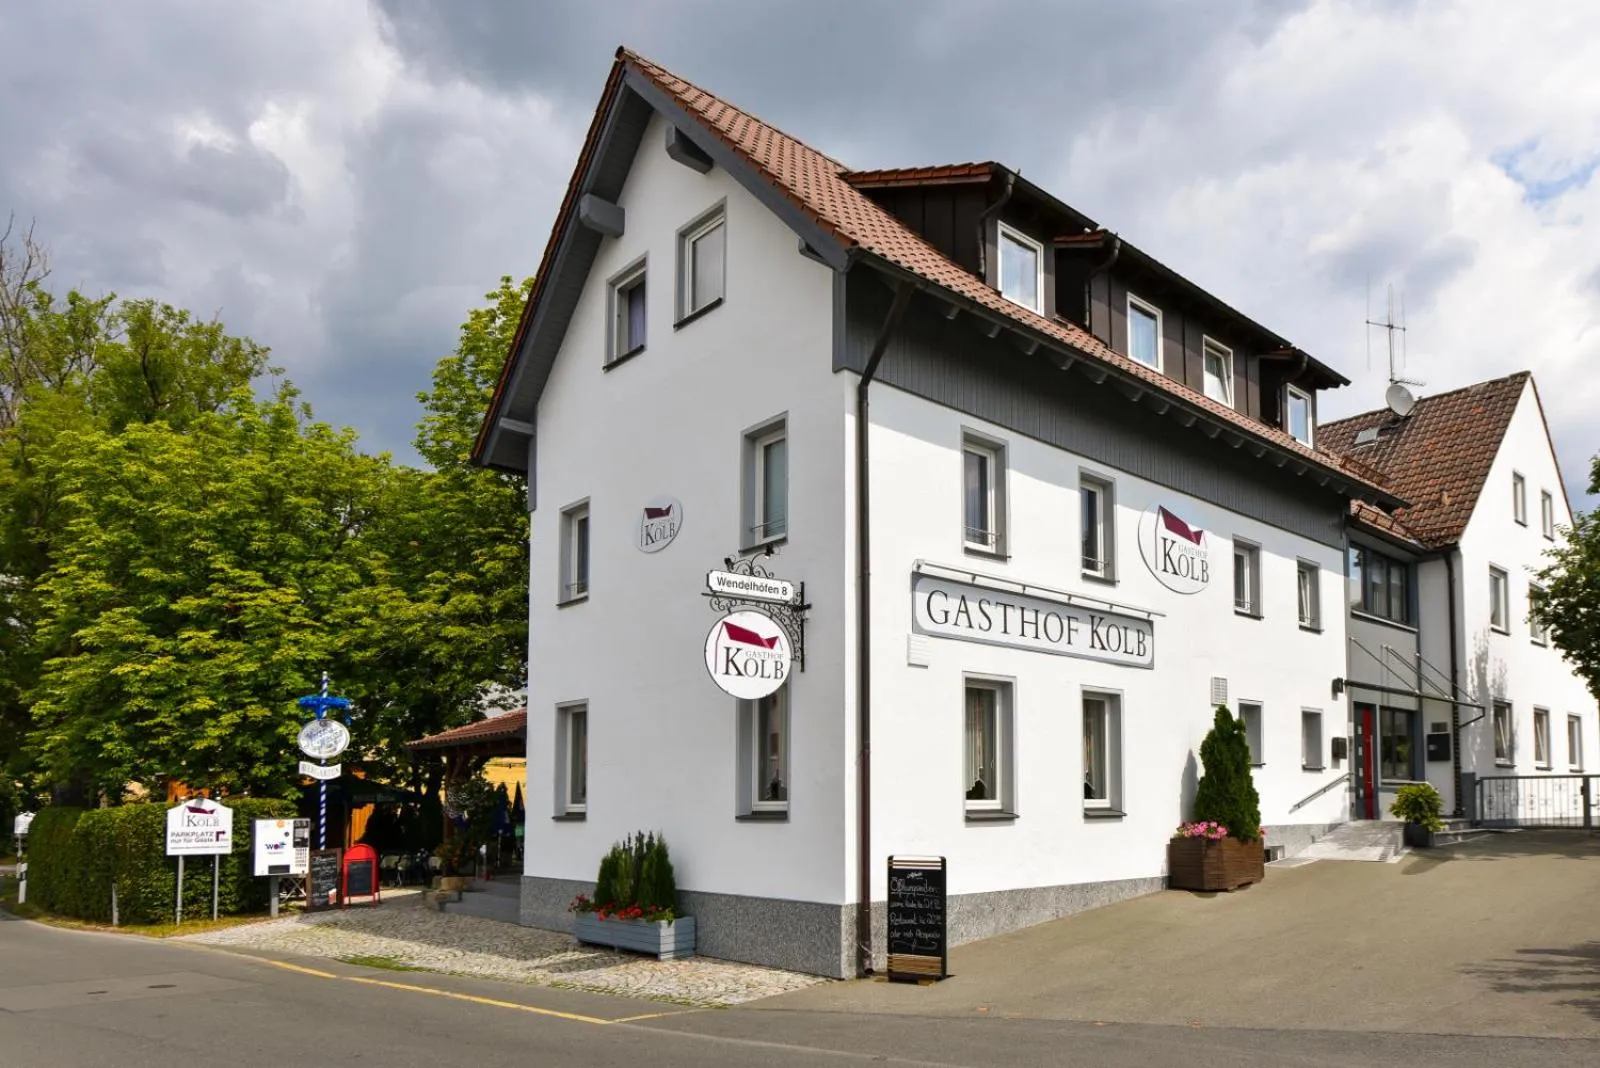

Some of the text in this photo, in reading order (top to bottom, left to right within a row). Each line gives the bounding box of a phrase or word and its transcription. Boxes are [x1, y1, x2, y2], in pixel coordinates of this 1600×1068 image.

[644, 522, 675, 546] KOLB
[1160, 536, 1210, 584] KOLB
[716, 576, 788, 596] Wendelhöfen 8
[926, 589, 1147, 657] GASTHOF KOLB
[722, 646, 784, 680] KOLB
[187, 815, 220, 827] KOLB
